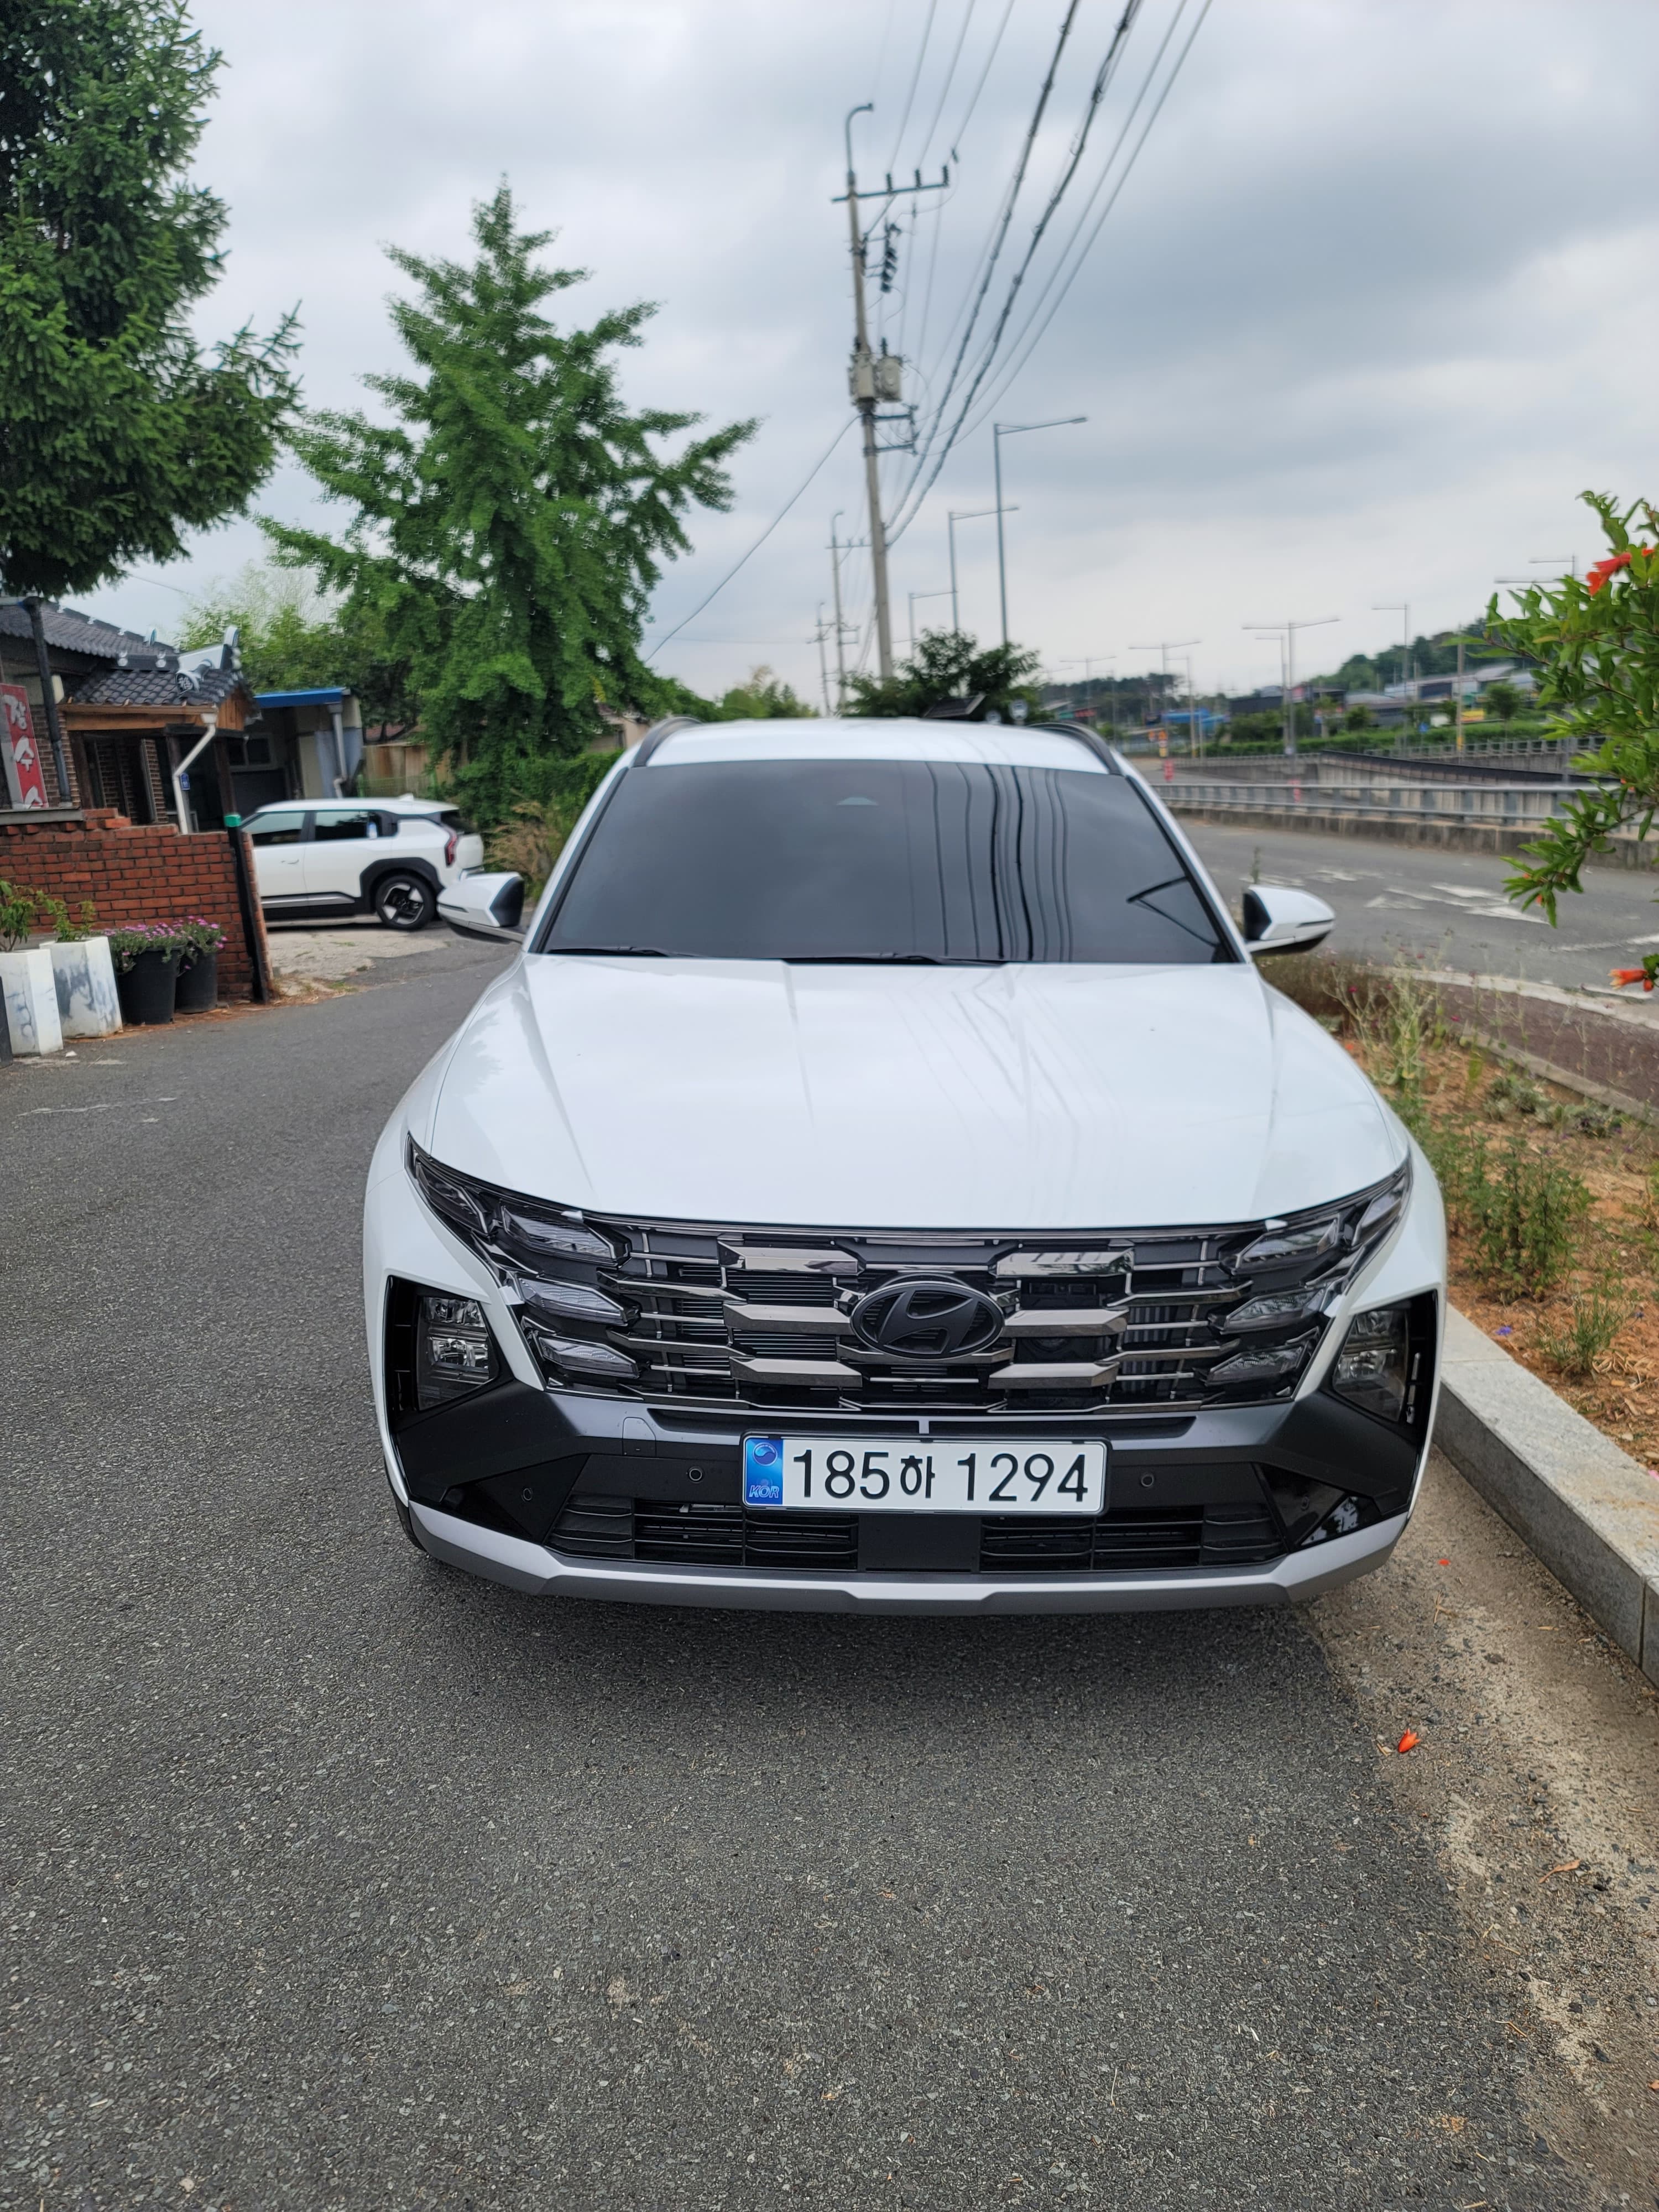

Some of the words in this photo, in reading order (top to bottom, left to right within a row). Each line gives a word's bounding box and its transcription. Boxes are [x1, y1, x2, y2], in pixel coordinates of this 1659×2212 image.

[749, 1485, 780, 1499] KOR
[793, 1449, 935, 1500] 185하
[957, 1453, 1088, 1502] 1294
